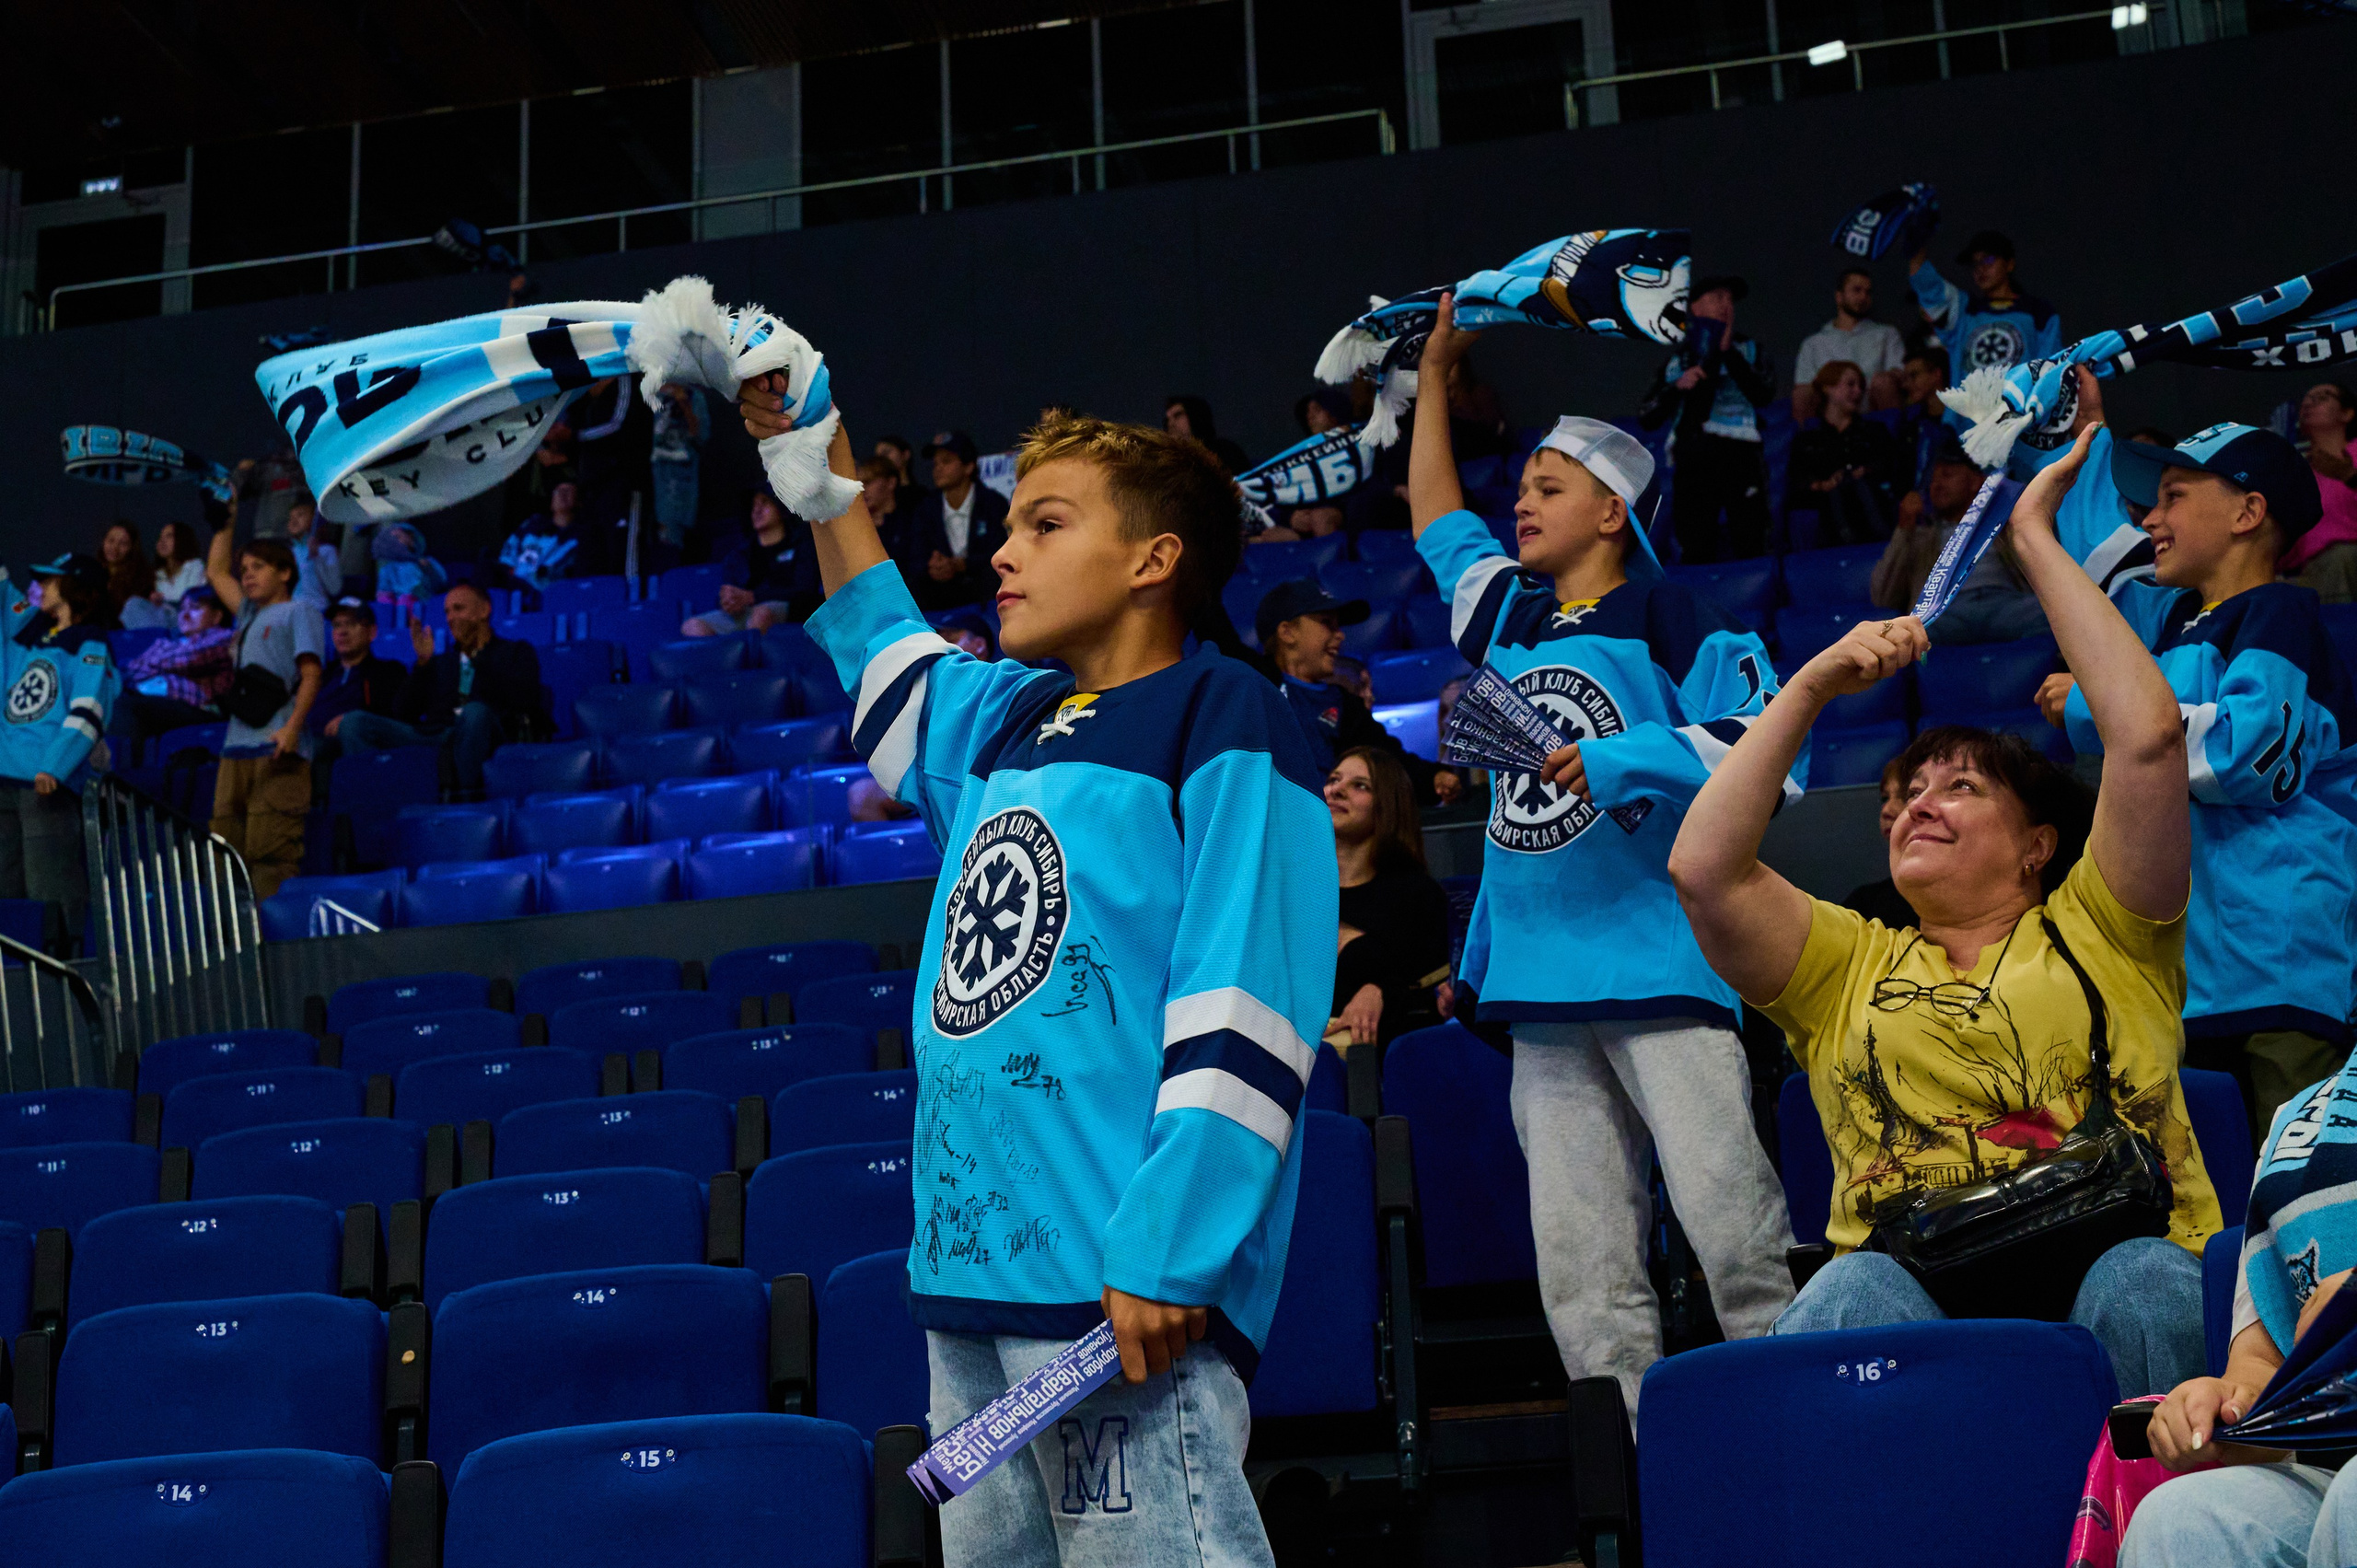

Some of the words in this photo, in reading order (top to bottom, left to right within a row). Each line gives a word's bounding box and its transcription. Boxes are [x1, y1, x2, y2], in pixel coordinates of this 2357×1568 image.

[1544, 673, 1584, 697] КЛУБ
[1504, 688, 1535, 720] Ткаченко
[2250, 700, 2306, 804] 15
[1005, 814, 1039, 844] КЛУБ
[1032, 833, 1062, 911] СИБИРЬ
[989, 931, 1054, 1012] ОБЛАСТЬ
[883, 1090, 897, 1100] 14
[610, 1111, 622, 1122] 13
[47, 1161, 57, 1172] 11
[881, 1160, 896, 1172] 14
[554, 1192, 569, 1204] 13
[193, 1220, 207, 1233] 12
[586, 1289, 605, 1304] 14
[211, 1322, 226, 1336] 13
[1076, 1330, 1113, 1359] Гусманов
[1856, 1362, 1881, 1382] 16
[986, 1361, 1085, 1441] Квартальнов
[639, 1450, 660, 1468] 15
[1058, 1417, 1132, 1514] M
[171, 1484, 192, 1501] 14
